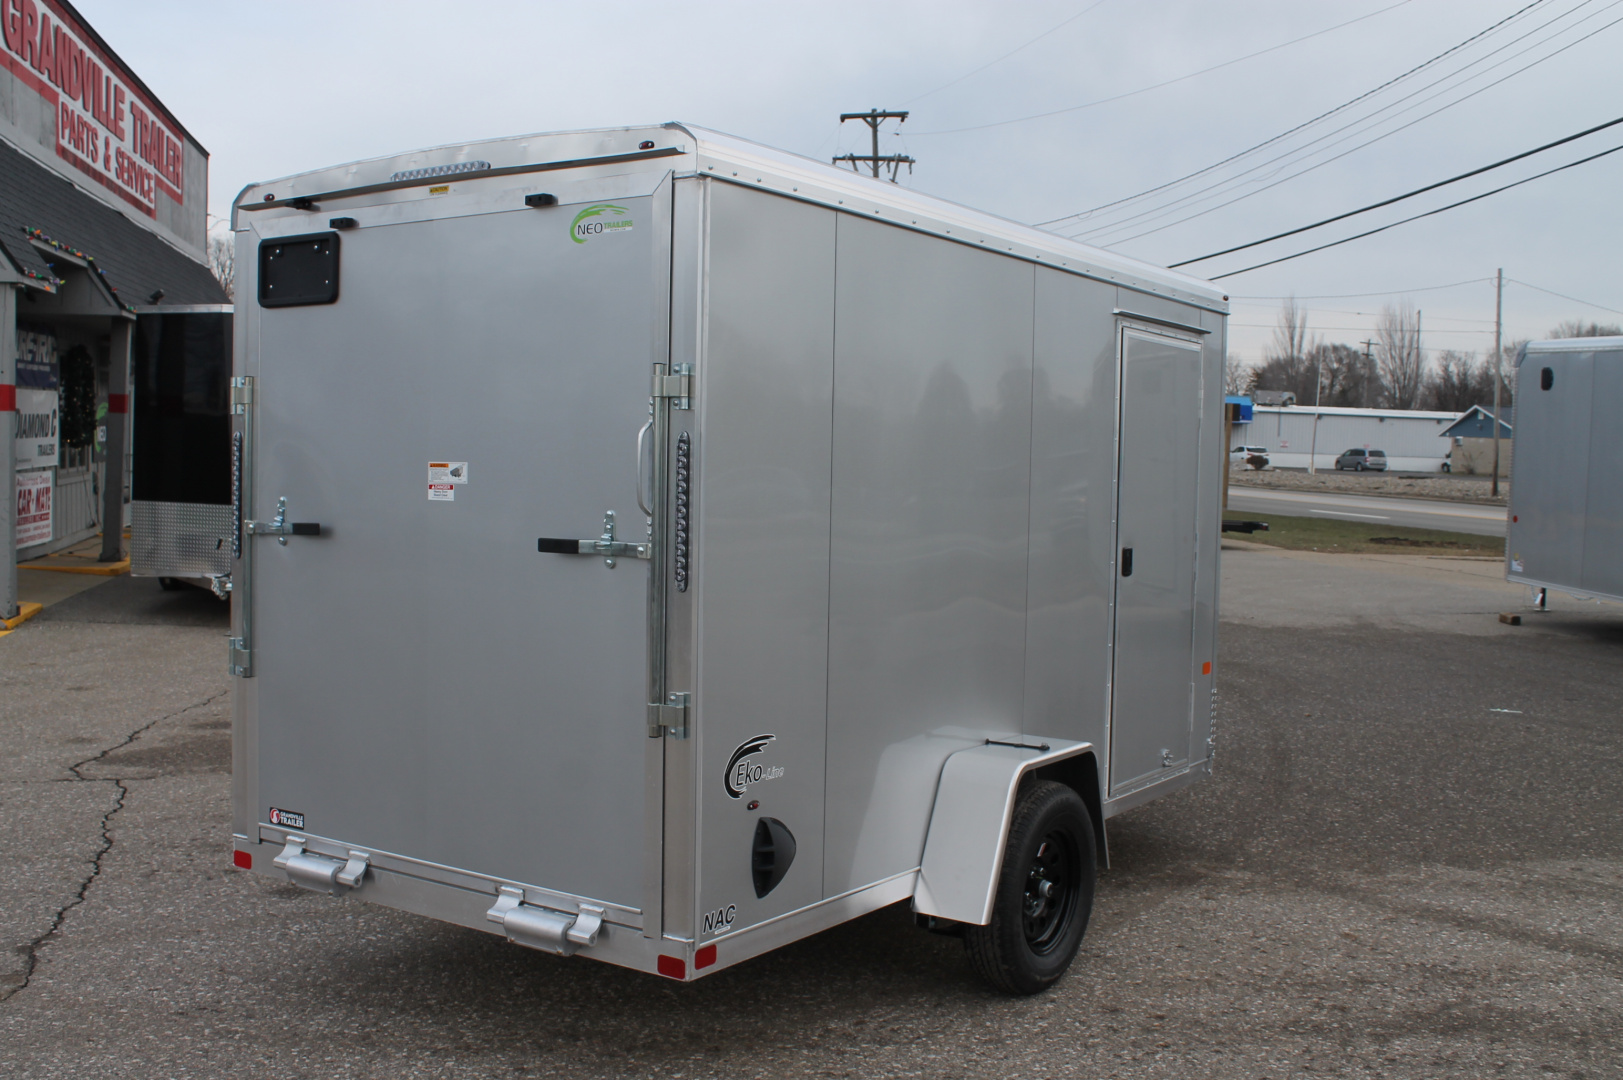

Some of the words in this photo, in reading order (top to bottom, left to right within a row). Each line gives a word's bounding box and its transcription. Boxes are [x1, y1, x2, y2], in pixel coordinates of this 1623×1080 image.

[1, 0, 126, 142] GRANDVILLE
[130, 100, 182, 190] TRAILER
[61, 101, 99, 164] PARTS
[104, 136, 112, 172] &
[115, 146, 155, 204] SERVICE
[577, 222, 603, 235] NEO
[604, 220, 633, 229] TRAILERS
[51, 408, 57, 438] C
[280, 816, 304, 828] TRAILER
[702, 904, 737, 934] NAC
